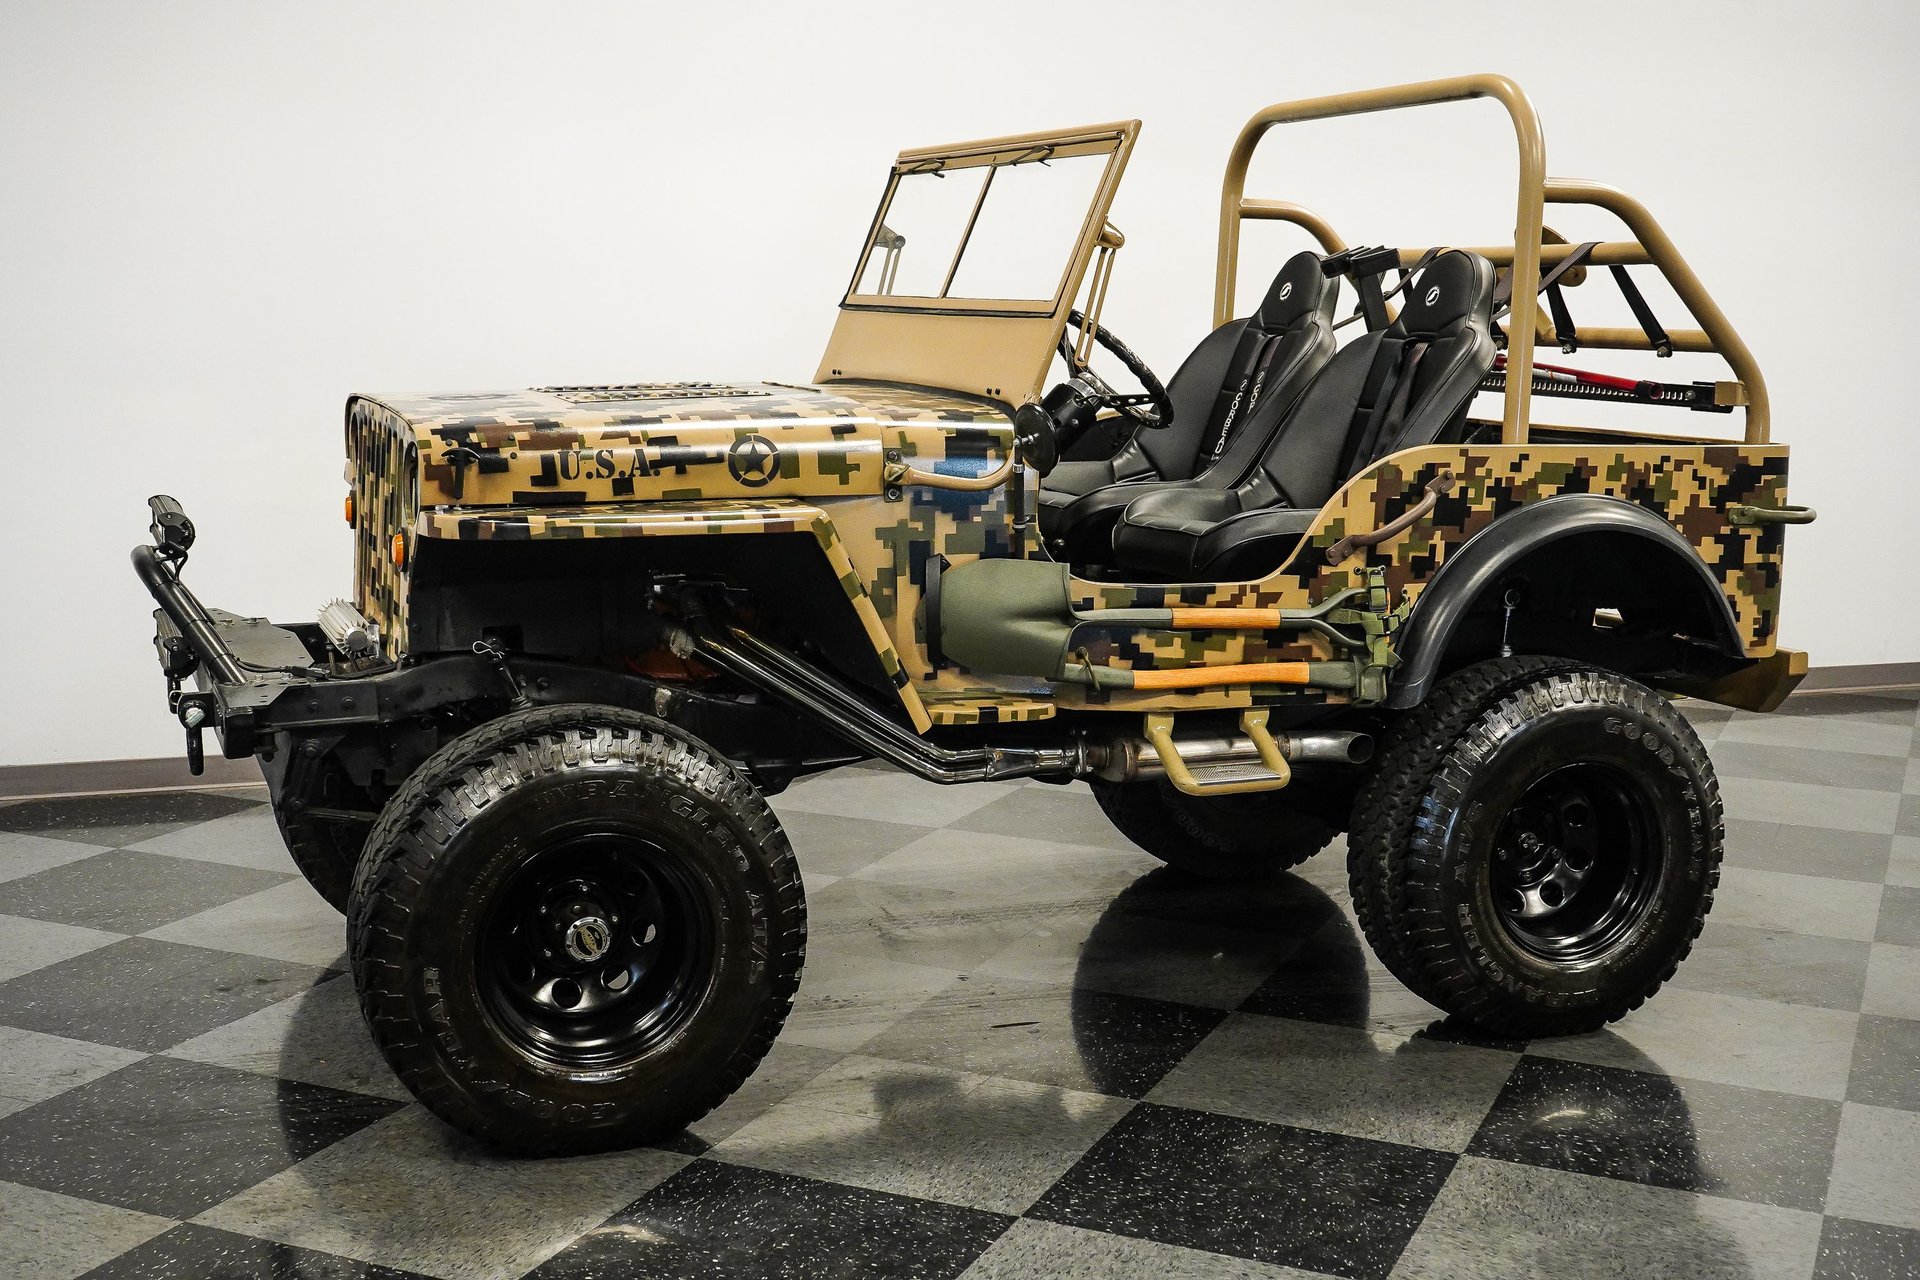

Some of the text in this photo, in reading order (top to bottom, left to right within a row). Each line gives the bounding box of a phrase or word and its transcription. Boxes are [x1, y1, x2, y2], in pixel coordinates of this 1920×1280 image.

[1214, 392, 1243, 454] CORBEAU
[558, 449, 661, 480] U.S.A.
[536, 778, 752, 873] WRANGLER
[745, 889, 769, 985] AT/S
